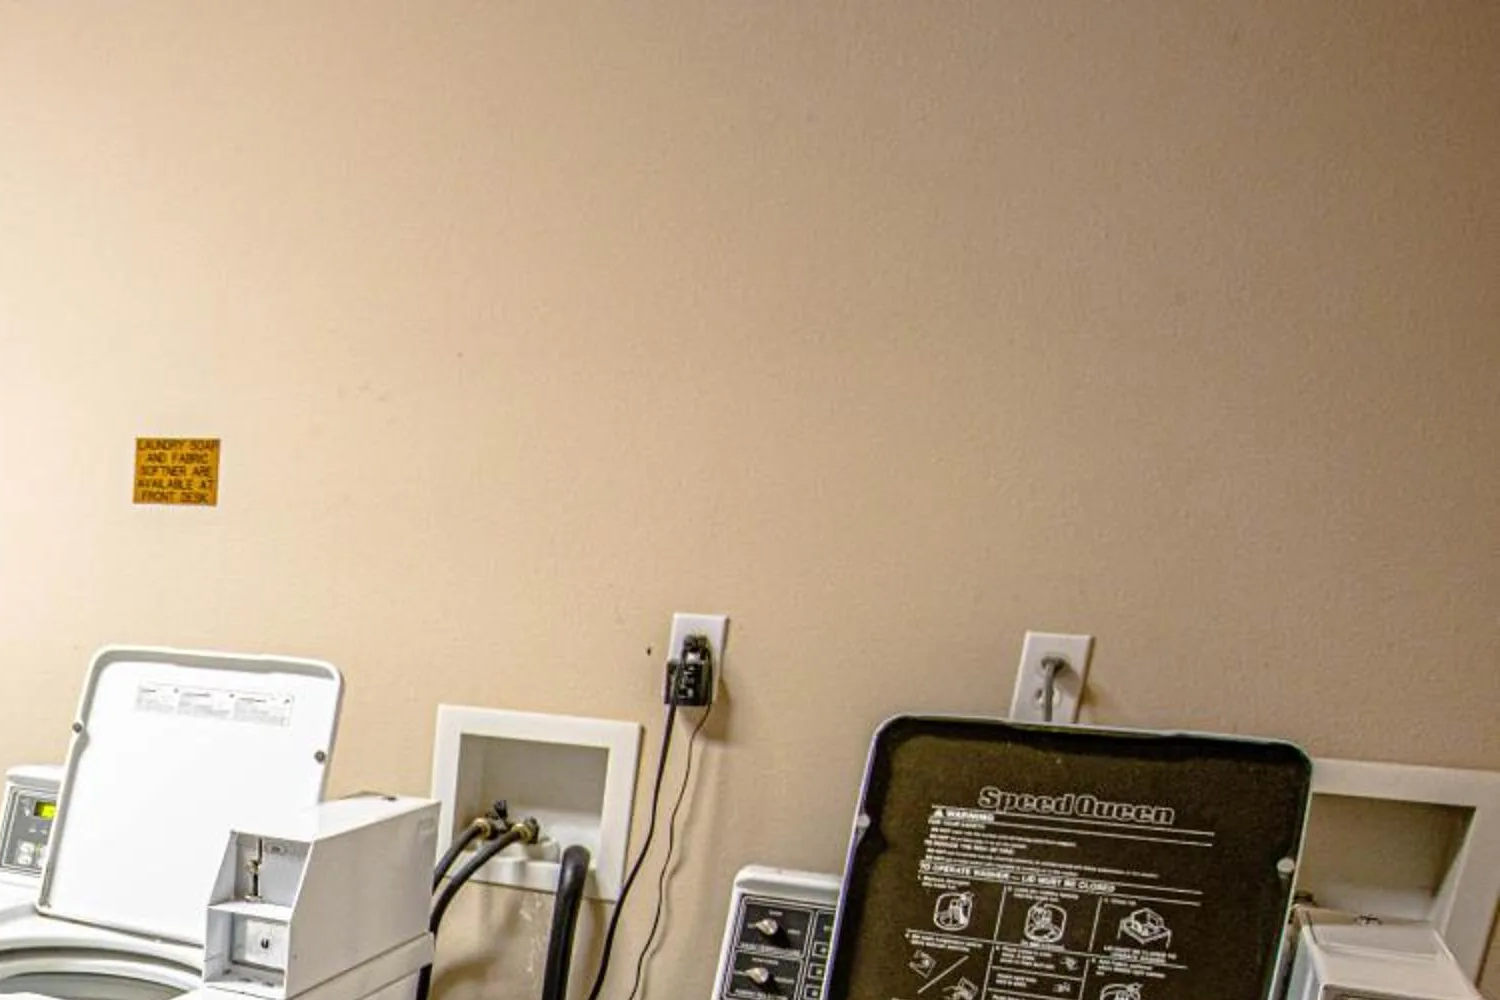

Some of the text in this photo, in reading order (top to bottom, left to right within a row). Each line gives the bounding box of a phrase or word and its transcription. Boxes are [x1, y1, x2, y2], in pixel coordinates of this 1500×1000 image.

[146, 452, 209, 464] AND FABRIC
[978, 786, 1176, 826] Speed Queen
